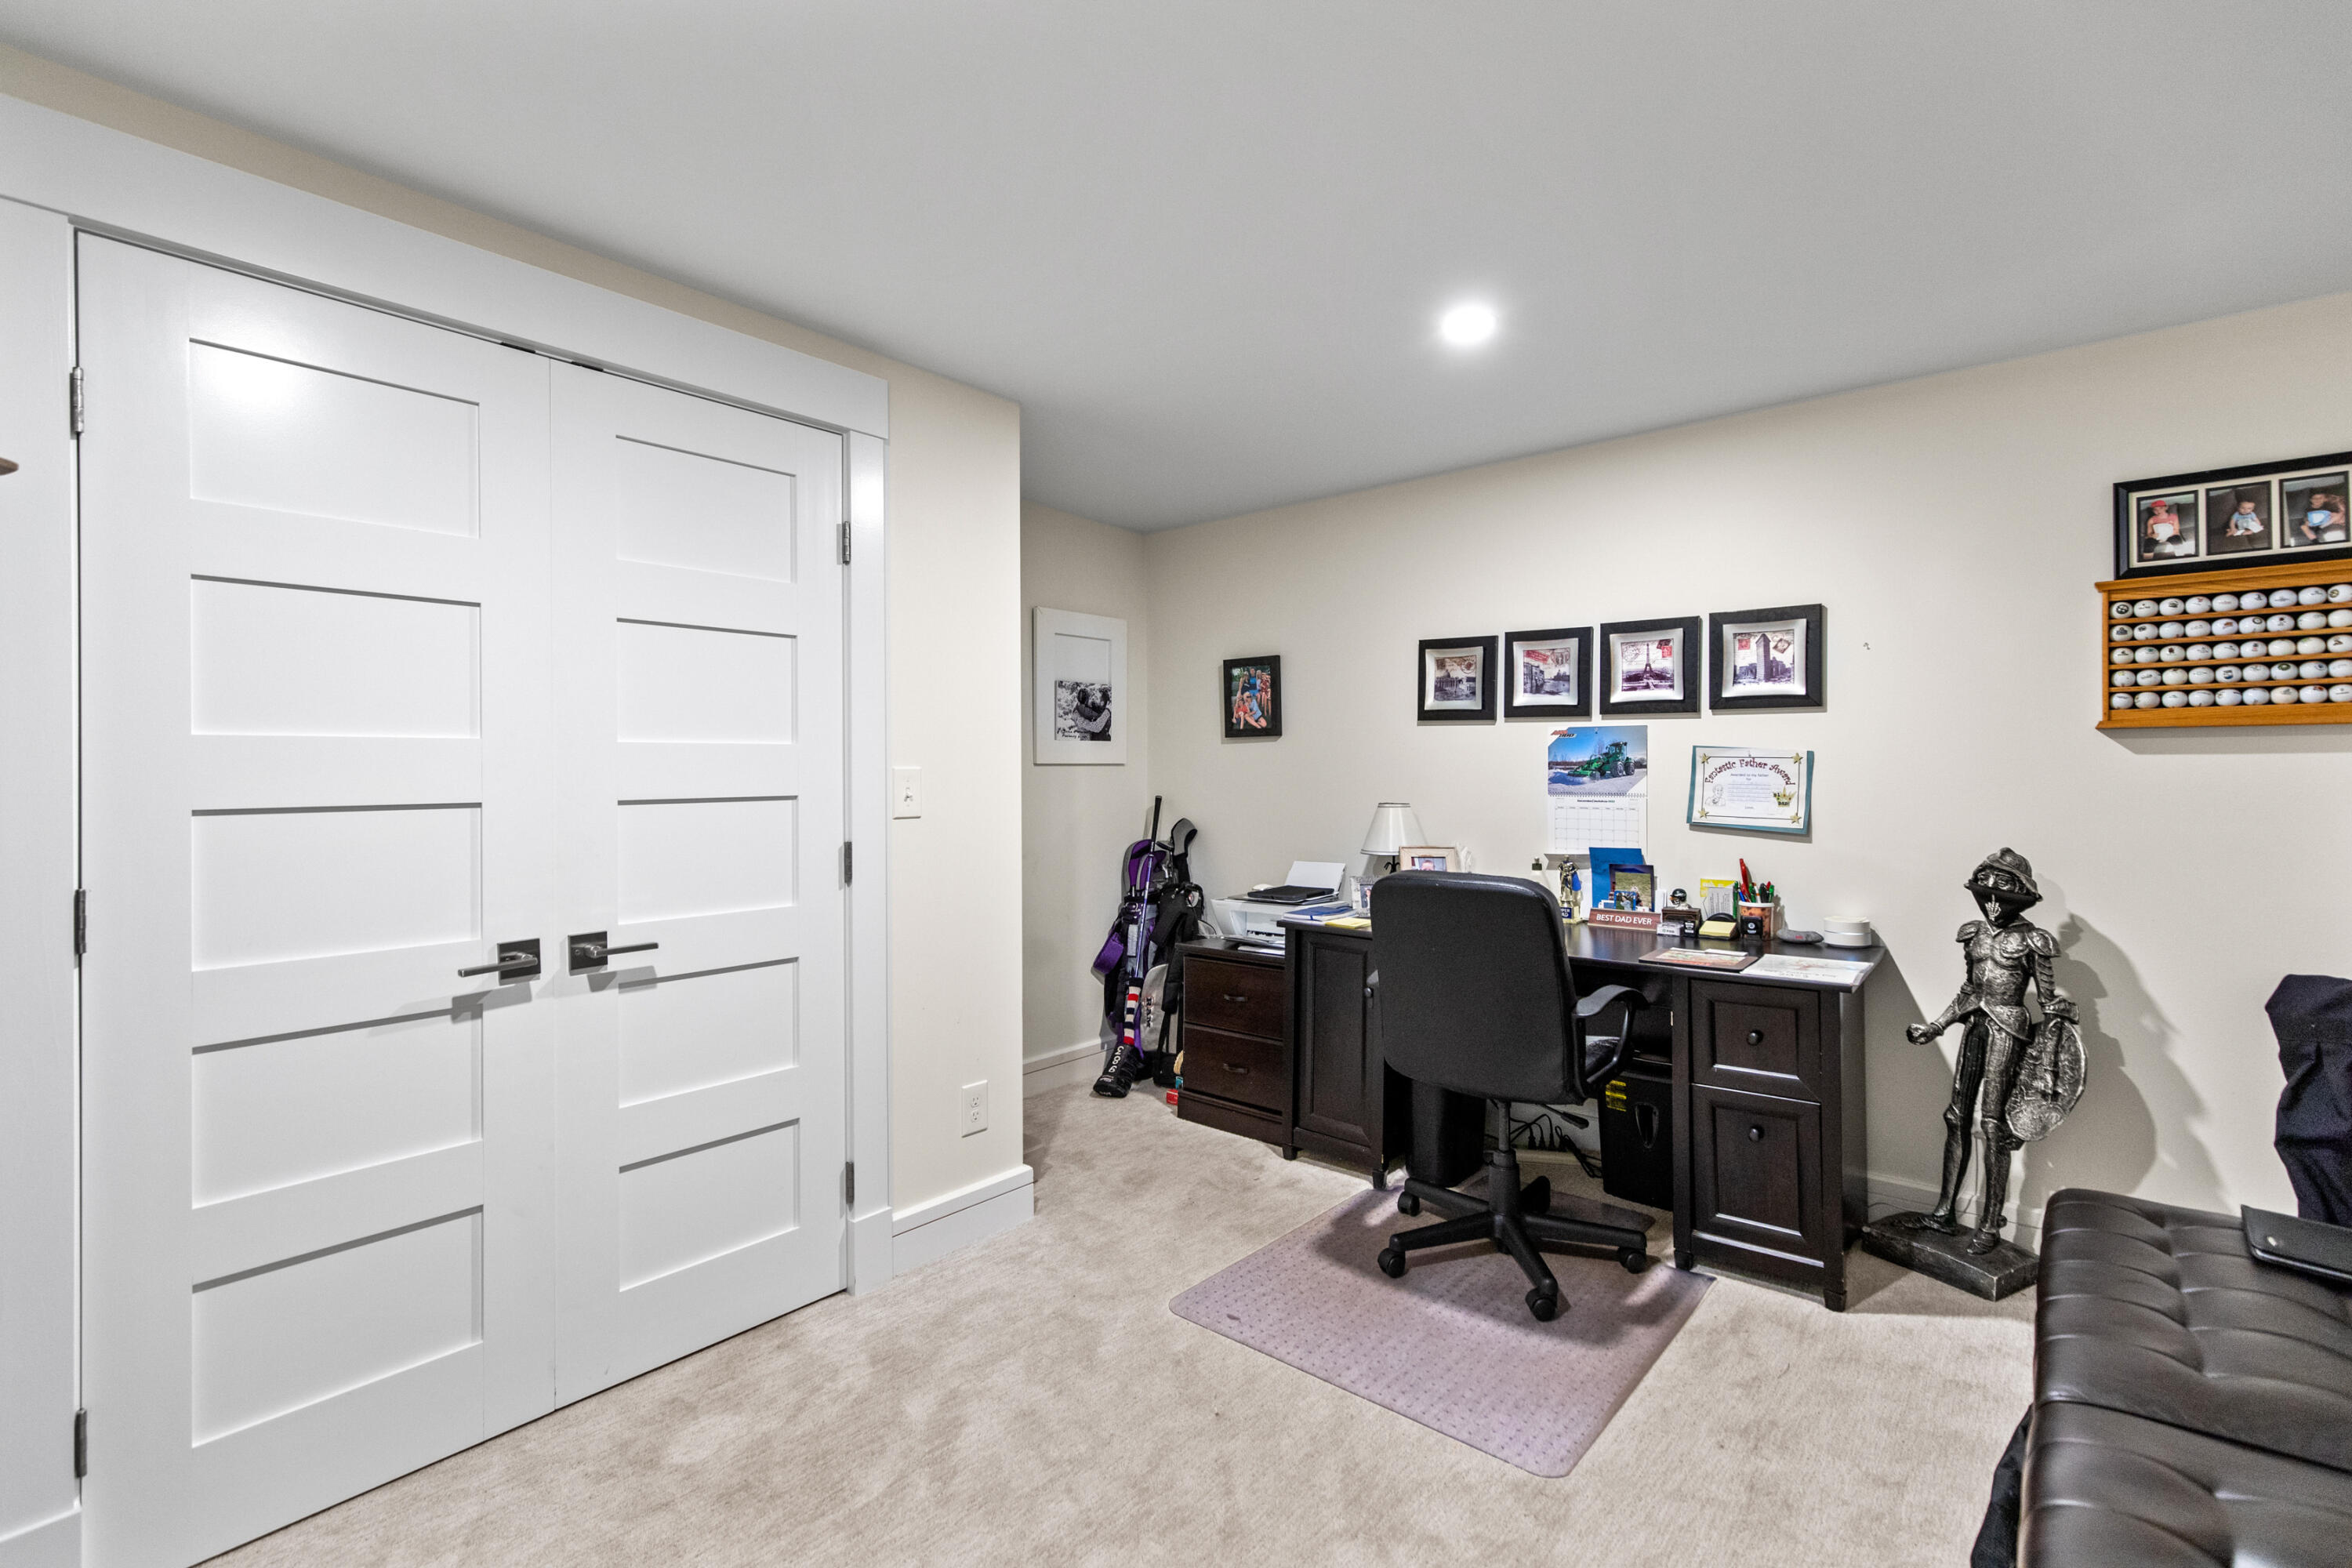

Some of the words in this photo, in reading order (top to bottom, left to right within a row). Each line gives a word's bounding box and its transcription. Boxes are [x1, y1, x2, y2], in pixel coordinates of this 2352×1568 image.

[1705, 760, 1737, 784] Fantastic
[1739, 757, 1768, 769] Father
[1769, 764, 1795, 786] Award
[1596, 913, 1614, 922] BEST
[1614, 915, 1632, 924] DAD
[1633, 916, 1652, 925] EVER
